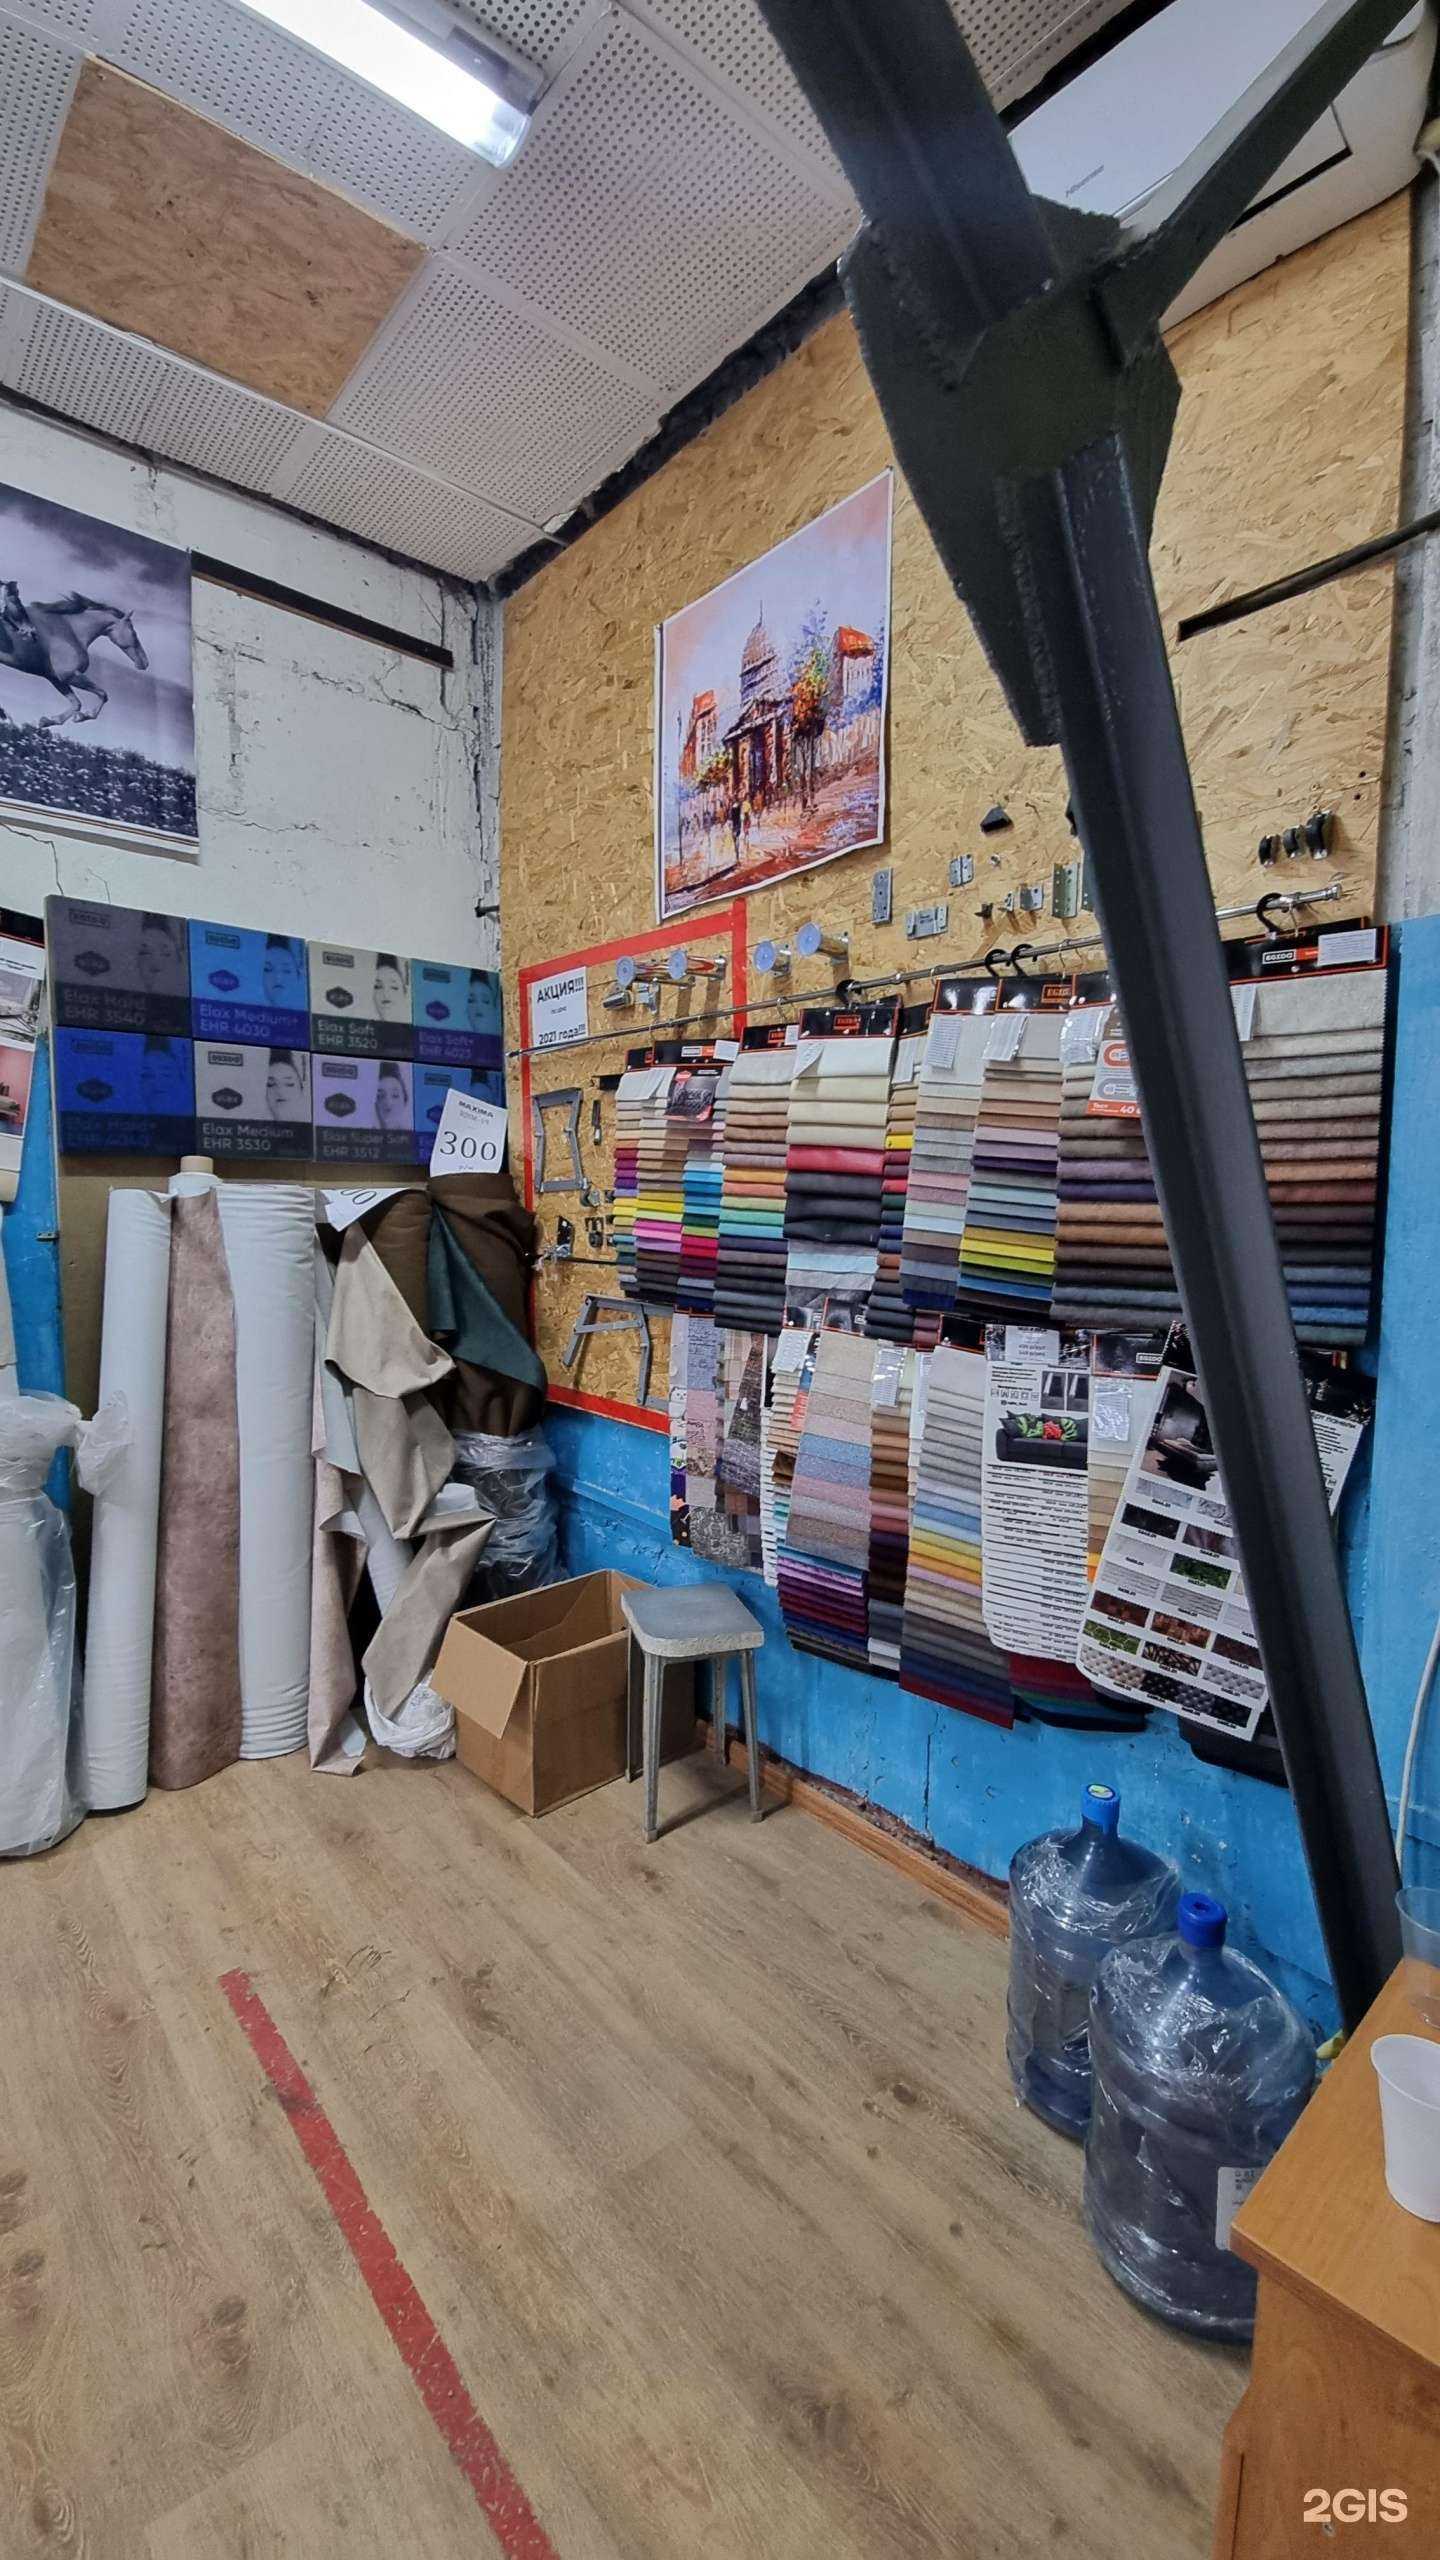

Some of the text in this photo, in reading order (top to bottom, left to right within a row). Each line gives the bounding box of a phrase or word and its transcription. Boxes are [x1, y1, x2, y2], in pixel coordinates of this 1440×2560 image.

[537, 977, 585, 1003] АКЦИЯ!!!
[200, 1003, 299, 1026] Elax Medium+
[200, 1018, 230, 1034] EHR
[317, 1019, 376, 1037] Elax Soft
[317, 1033, 379, 1050] EHR 3520
[538, 1030, 557, 1045] 2021
[202, 1122, 295, 1139] Elax Medium
[202, 1136, 272, 1153] EHR 3530
[438, 1130, 497, 1161] 300
